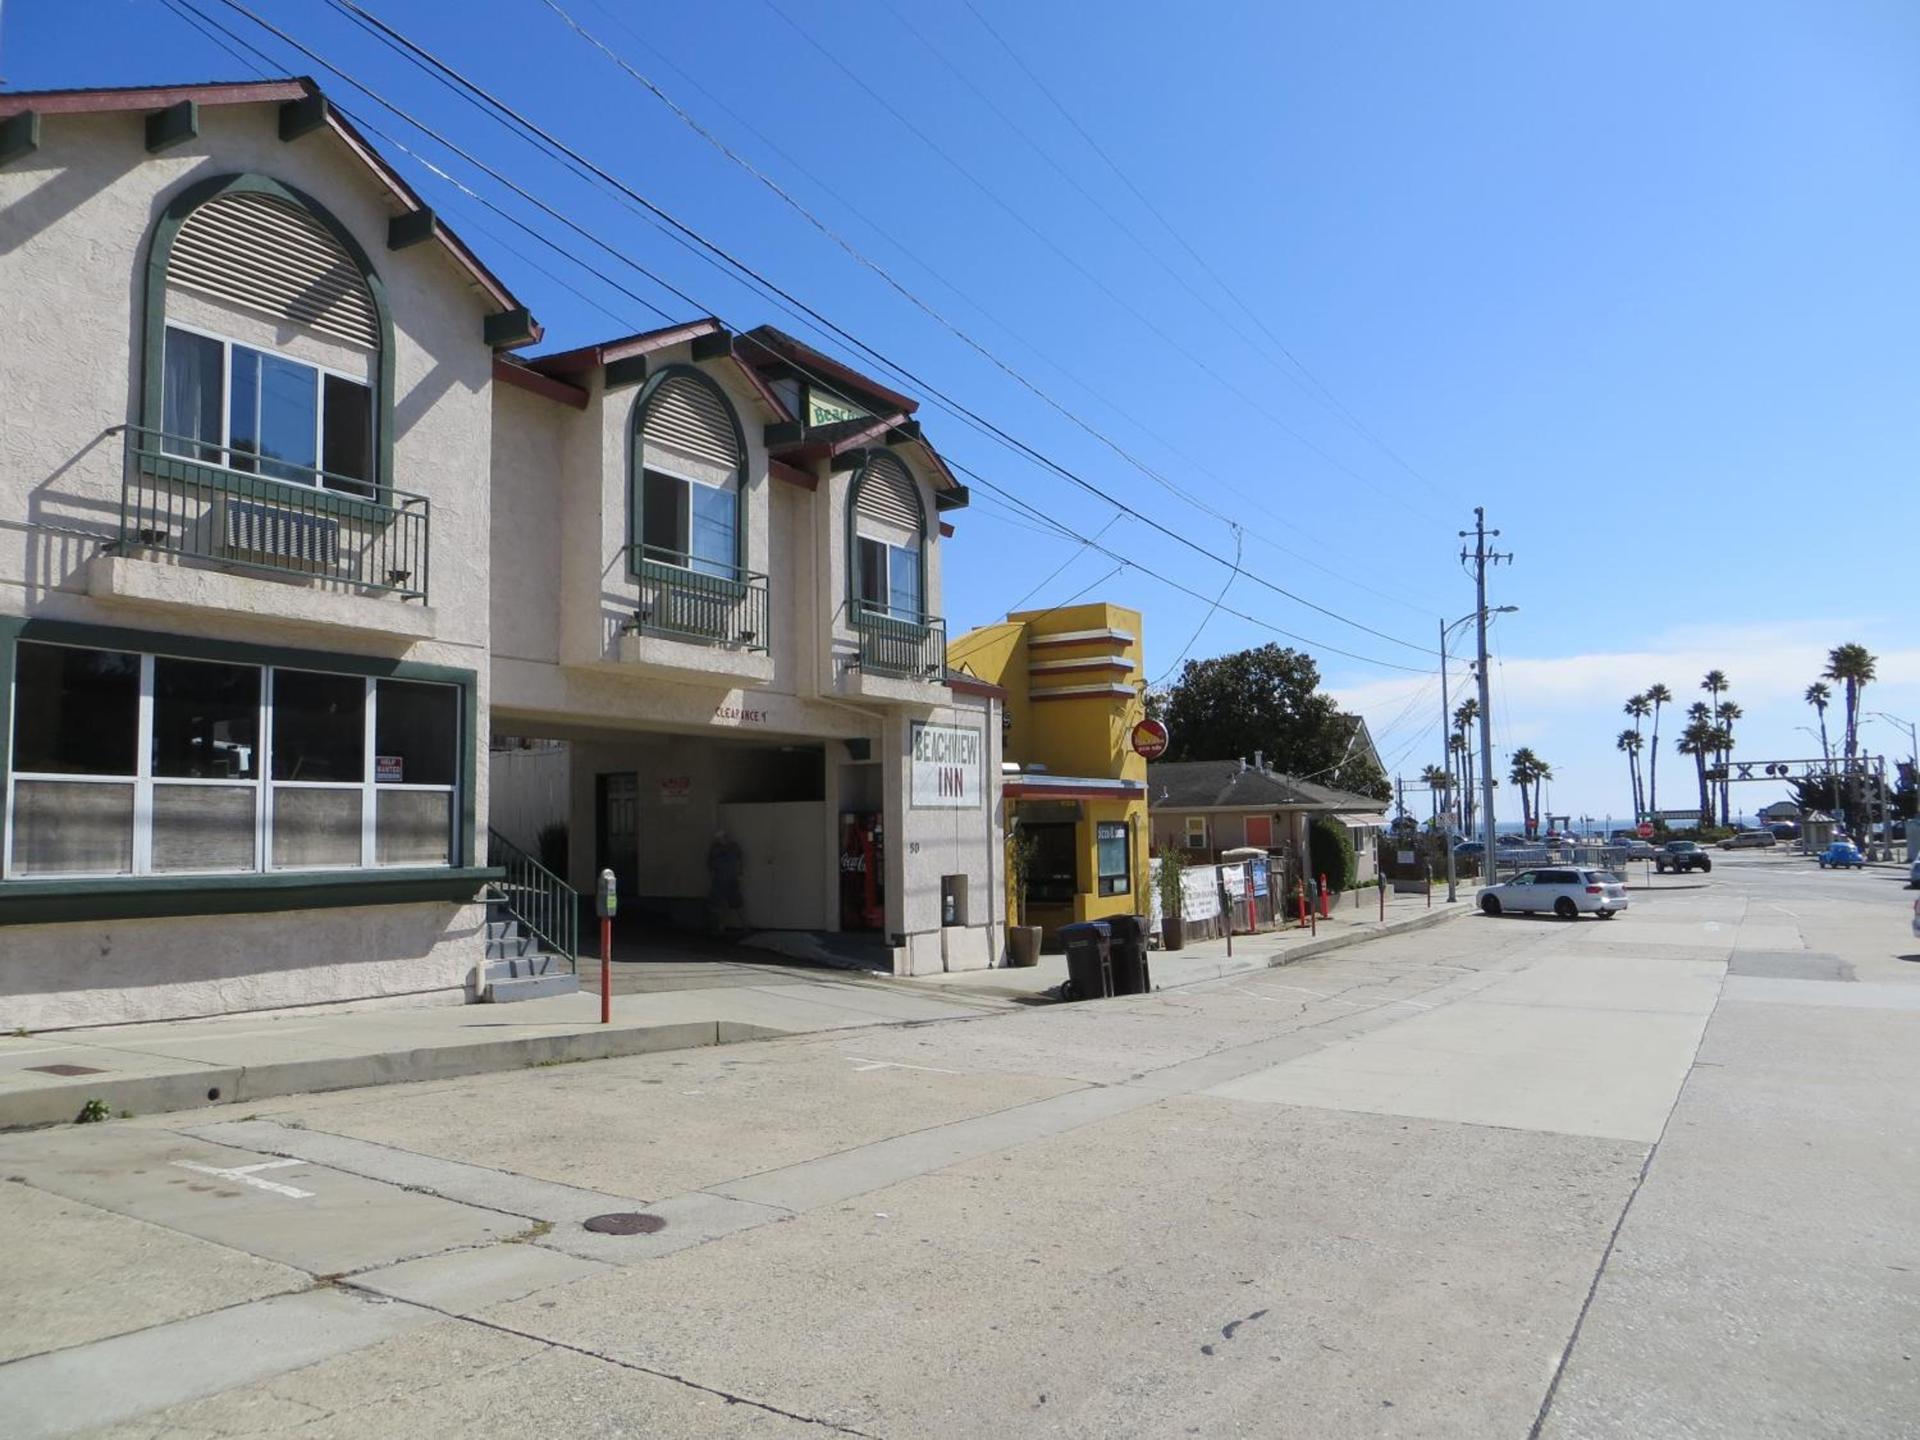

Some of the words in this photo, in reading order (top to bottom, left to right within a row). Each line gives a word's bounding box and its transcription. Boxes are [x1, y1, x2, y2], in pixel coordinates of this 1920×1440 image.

[714, 706, 759, 722] CLEARANCE
[915, 730, 977, 765] BEACHVIEW
[938, 767, 963, 797] INN
[909, 842, 920, 855] 50
